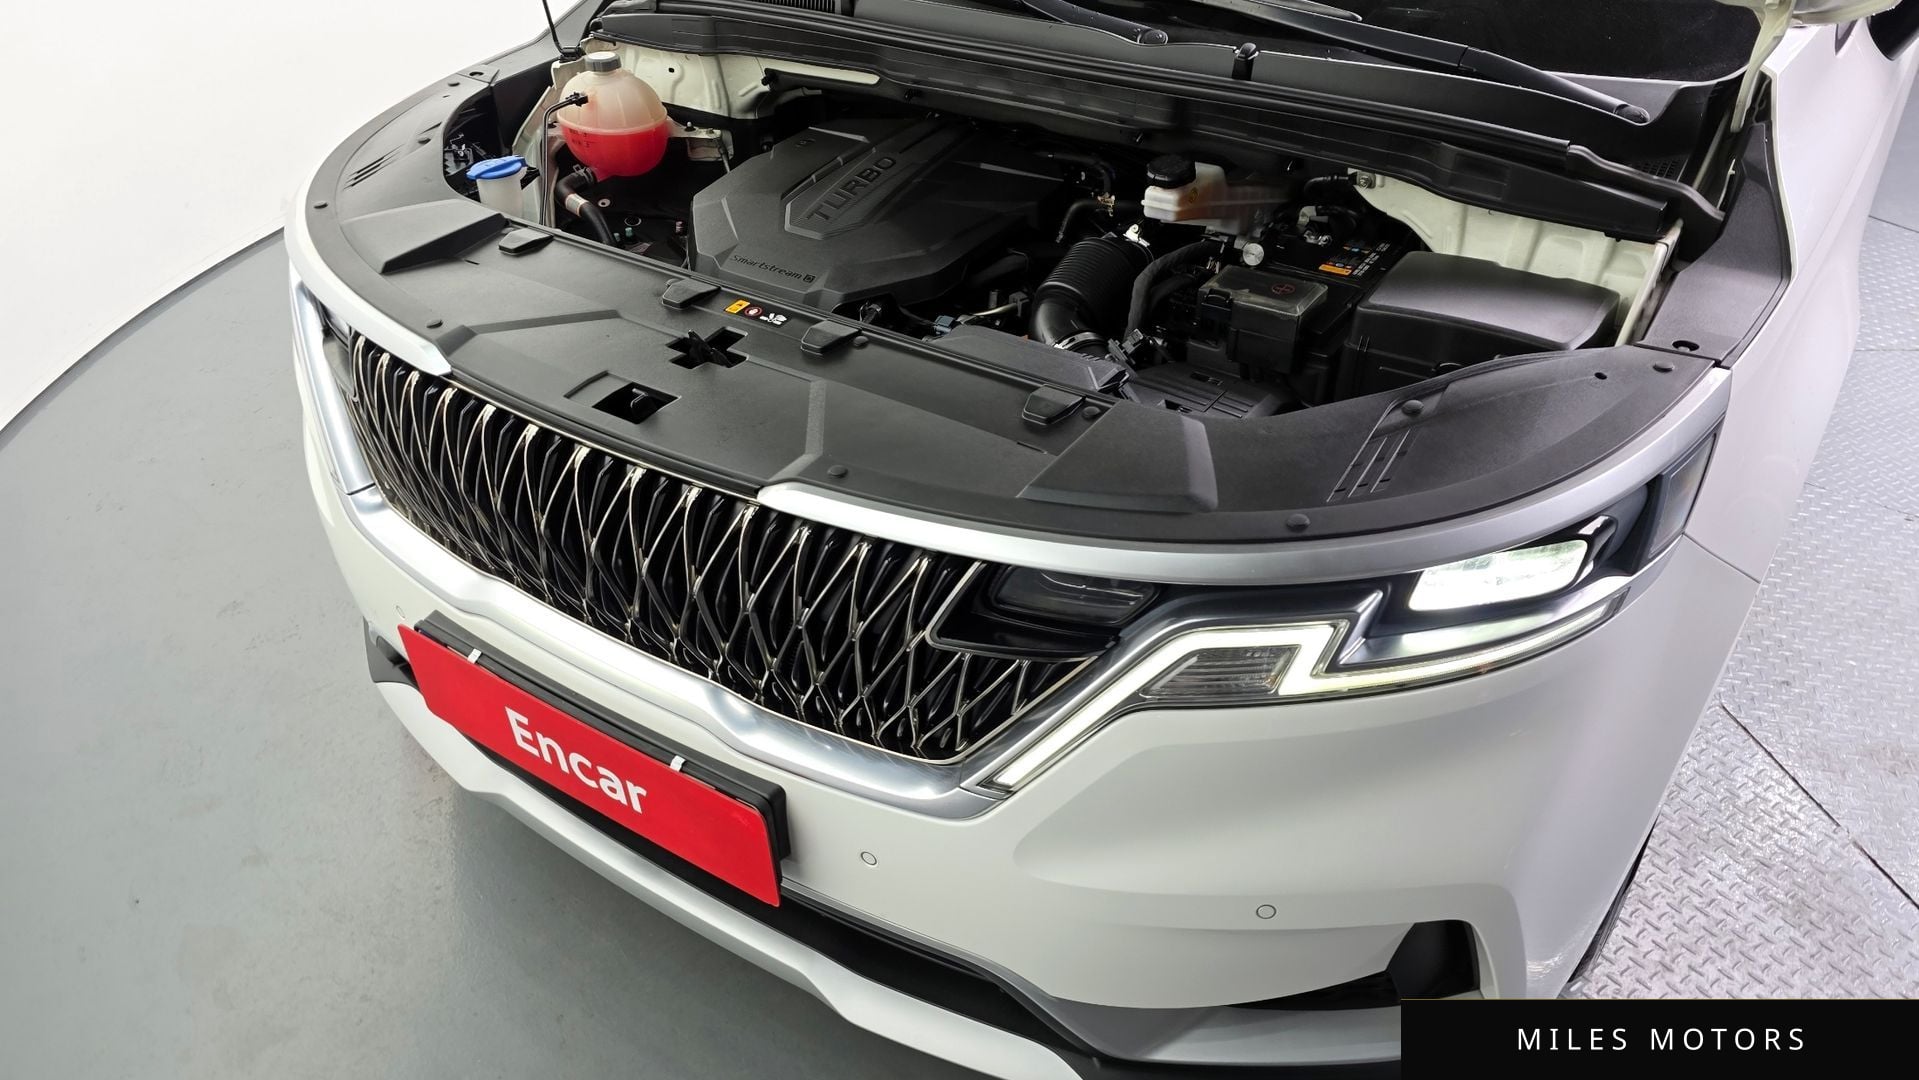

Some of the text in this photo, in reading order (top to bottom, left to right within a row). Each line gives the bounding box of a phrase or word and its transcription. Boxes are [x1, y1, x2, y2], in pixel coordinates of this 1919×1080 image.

[805, 156, 897, 220] TURBO
[732, 254, 803, 280] Smartstream
[504, 706, 648, 815] Encar
